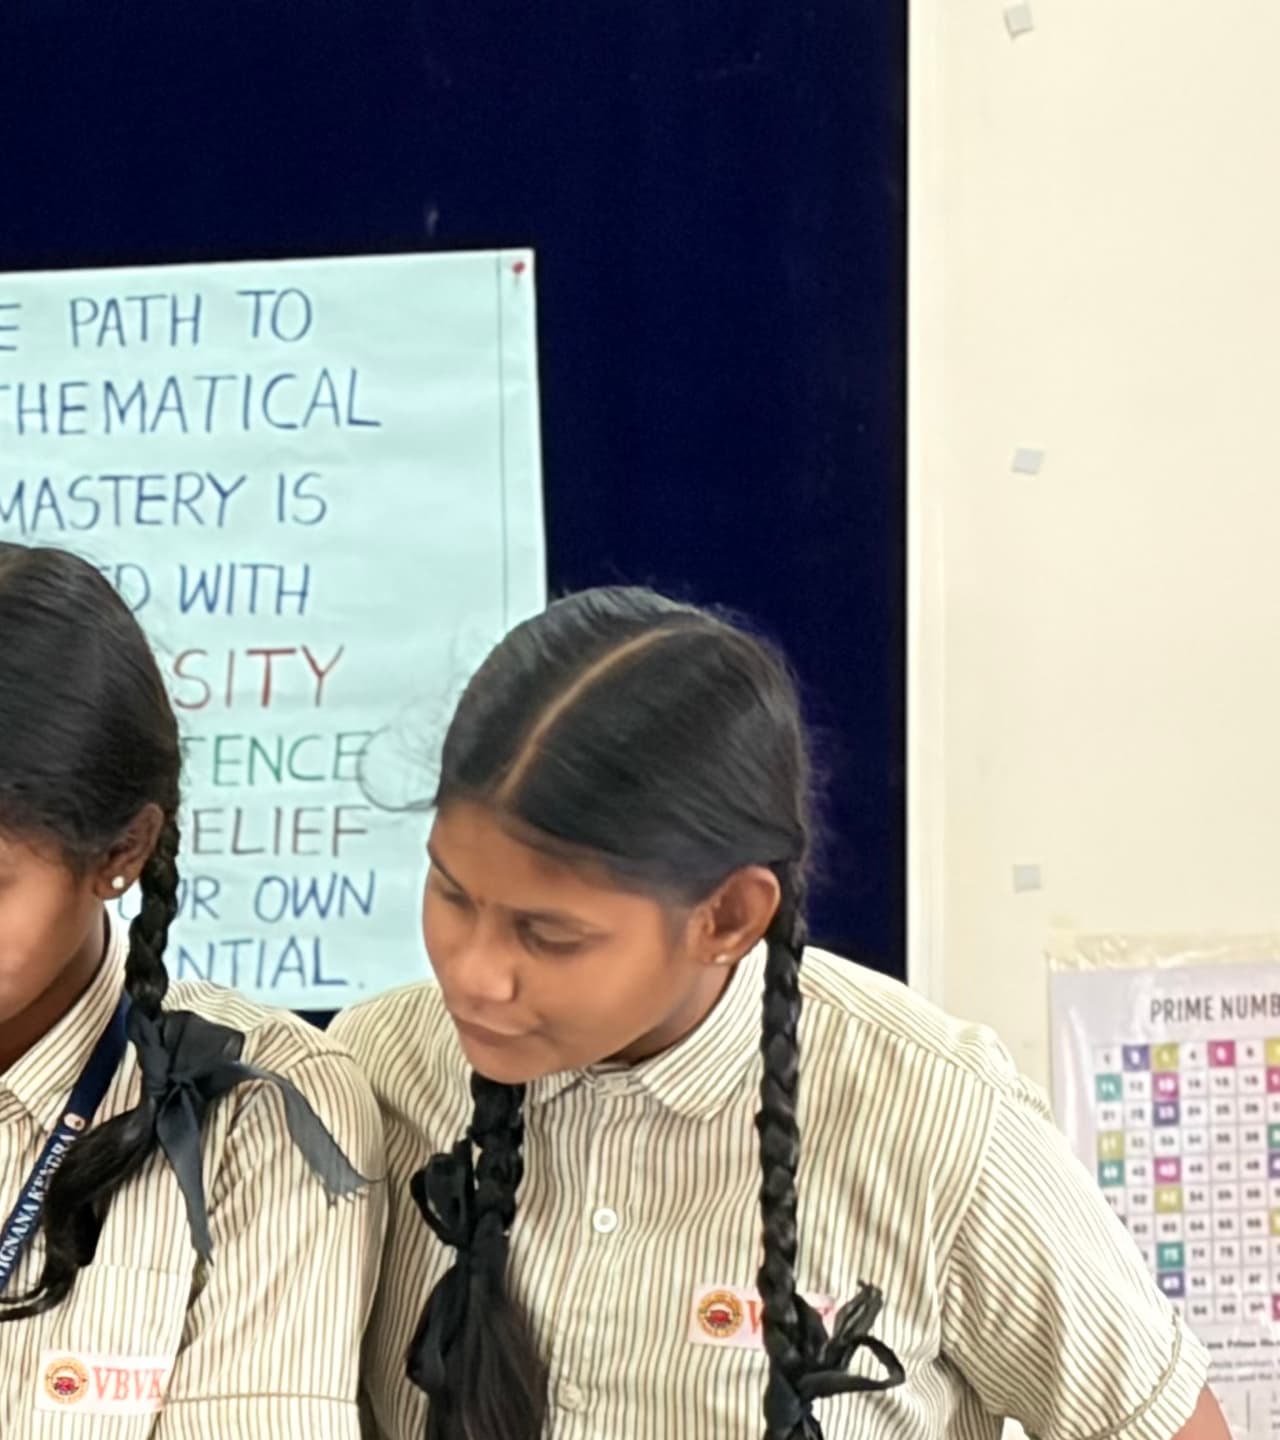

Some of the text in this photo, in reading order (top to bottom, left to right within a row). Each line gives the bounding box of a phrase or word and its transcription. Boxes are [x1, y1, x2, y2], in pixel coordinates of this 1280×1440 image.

[68, 293, 203, 349] PATH
[236, 287, 314, 343] TO
[276, 471, 329, 527] IS
[178, 562, 311, 616] WITH
[254, 869, 376, 923] OWN
[1150, 991, 1280, 1024] PRIME NUMB
[92, 1365, 167, 1401] VBVK
